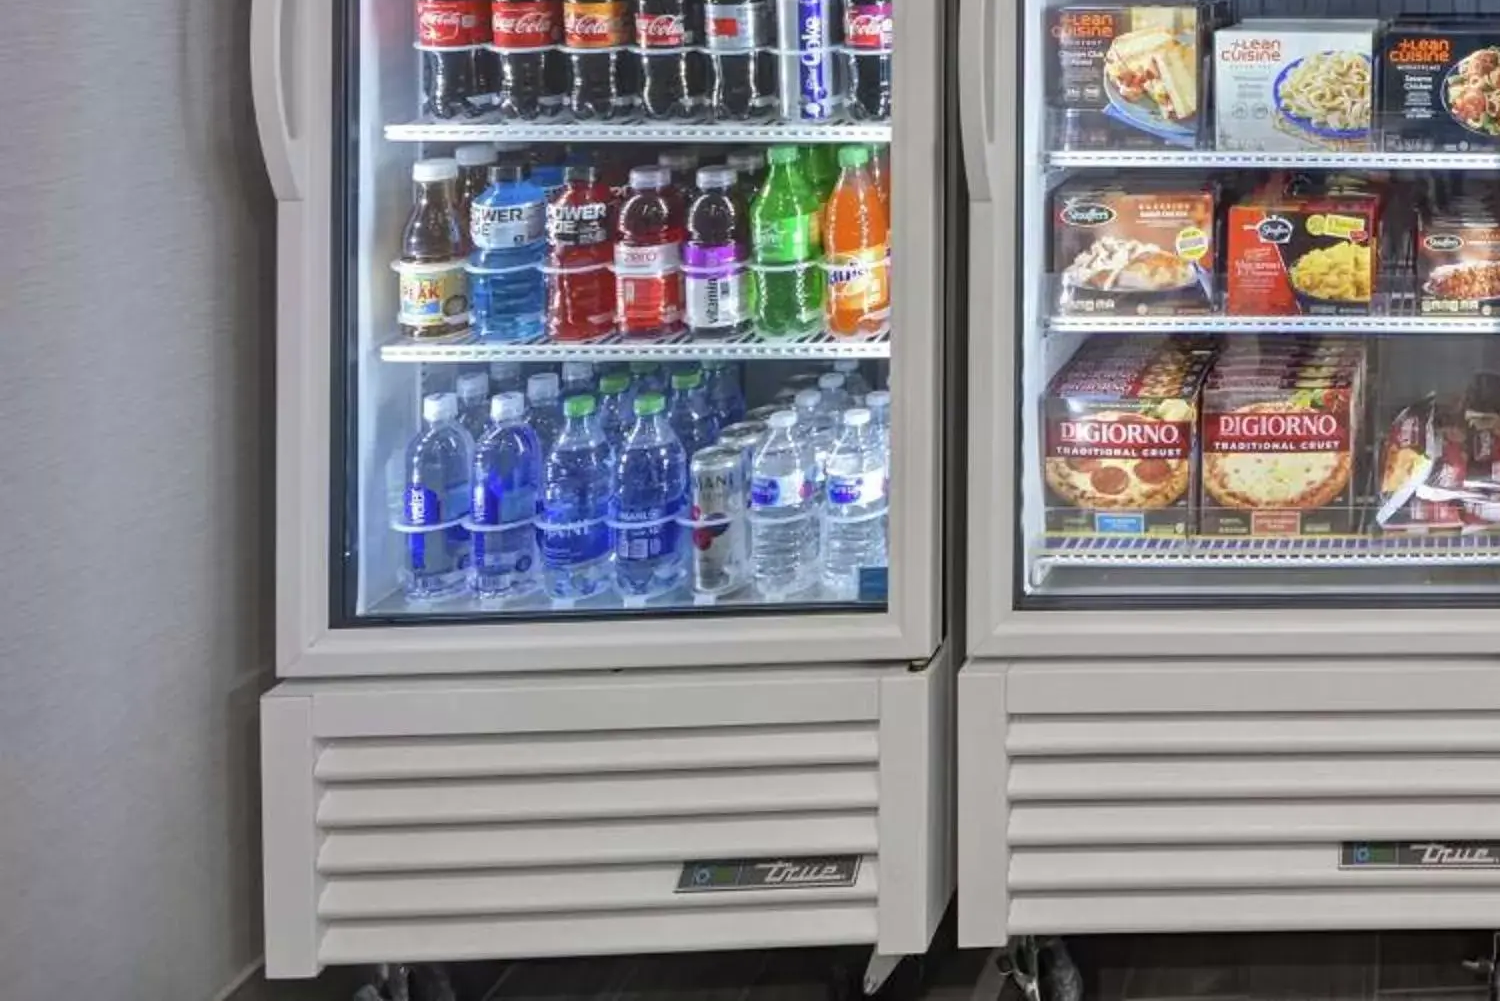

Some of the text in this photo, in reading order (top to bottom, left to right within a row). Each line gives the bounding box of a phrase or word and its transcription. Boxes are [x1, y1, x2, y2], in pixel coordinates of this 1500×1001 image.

[1214, 440, 1341, 450] TRADITIONAL CRUST
[1056, 446, 1182, 457] TRADITIONAL CRUST
[1410, 843, 1497, 866] True
